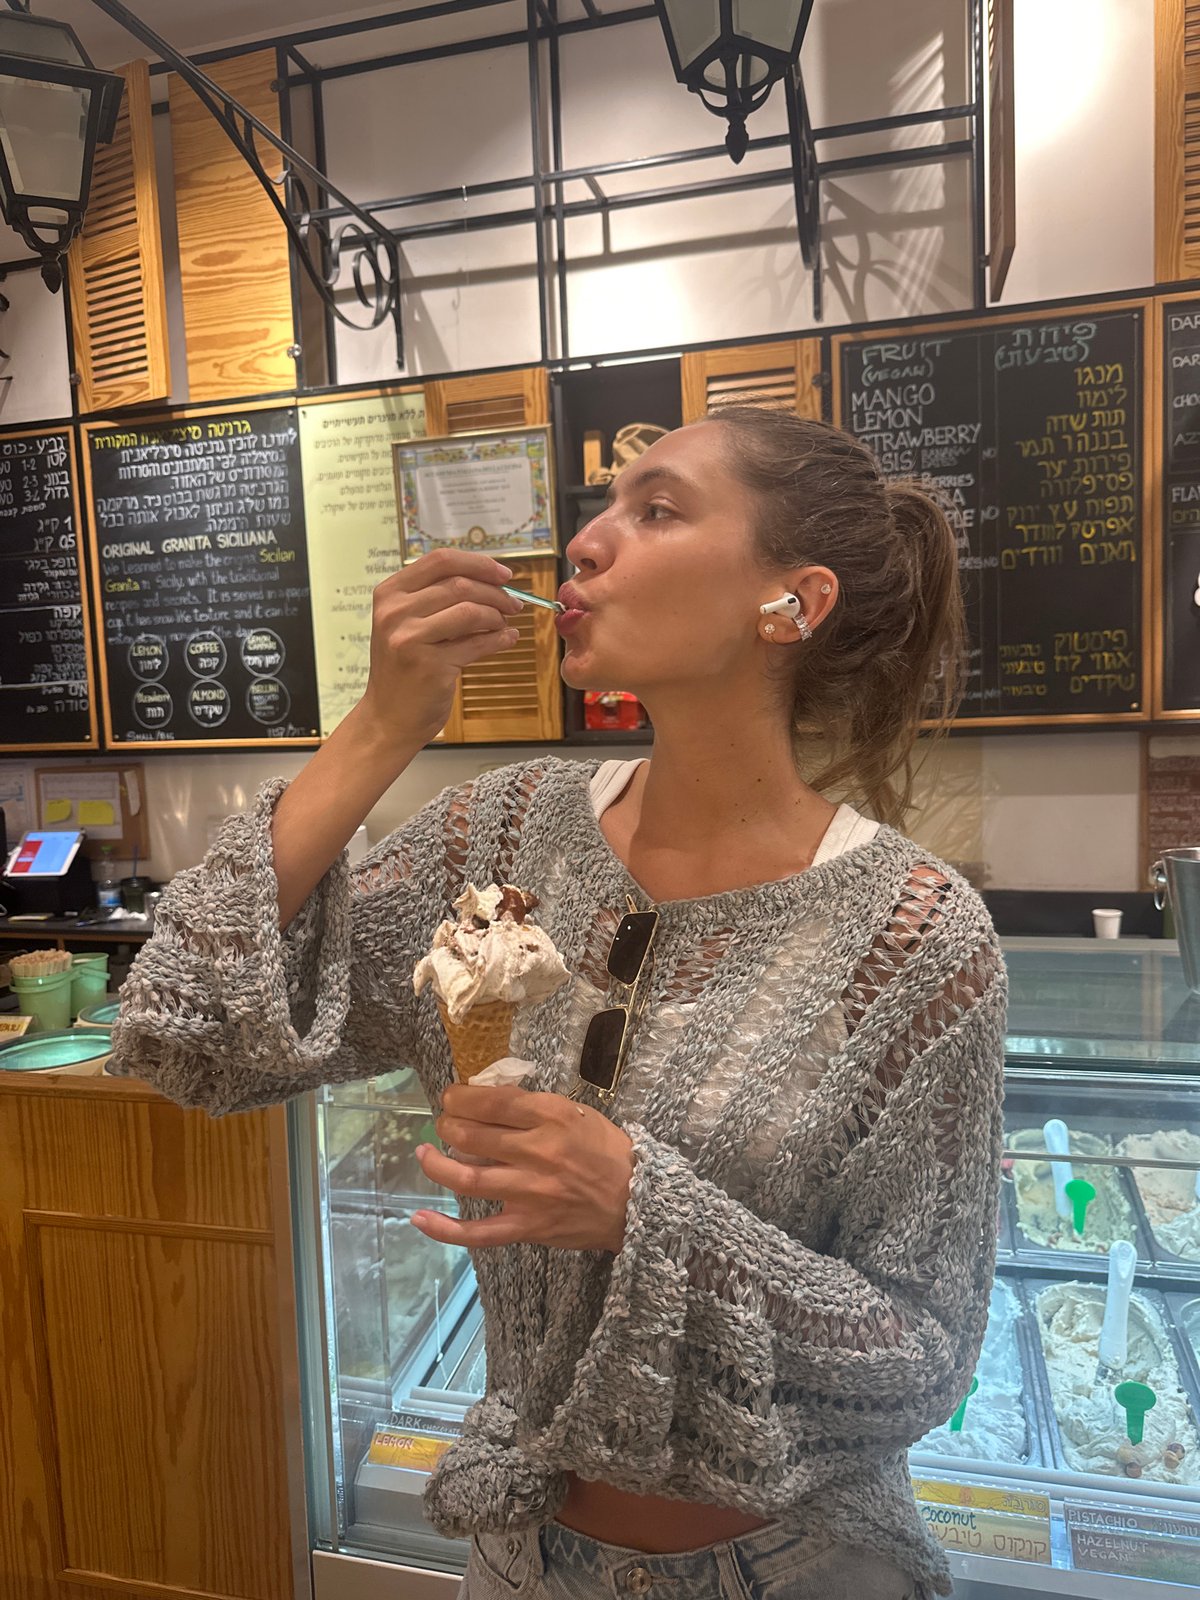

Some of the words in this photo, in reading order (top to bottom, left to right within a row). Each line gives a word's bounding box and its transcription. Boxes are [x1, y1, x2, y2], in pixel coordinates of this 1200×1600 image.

[862, 338, 952, 365] FRUIT
[1073, 363, 1124, 385] מנגו
[852, 383, 936, 412] MANGO
[853, 405, 923, 433] LEMON
[1091, 409, 1126, 427] תות
[36, 436, 66, 455] גביע
[102, 541, 155, 558] ORIGINAL
[161, 535, 213, 553] GRANITA
[216, 530, 279, 548] SICILIANA
[259, 549, 296, 564] Sicilian
[105, 577, 141, 593] Granita
[132, 644, 163, 657] LEMON
[188, 641, 221, 655] COFFEE
[192, 688, 226, 702] ALMOND
[390, 1412, 421, 1428] DARK
[376, 1432, 415, 1449] LEMON
[1068, 1508, 1138, 1529] PISTACHIO
[1077, 1533, 1150, 1553] HAZELNUT
[1079, 1547, 1129, 1562] VEGAN
